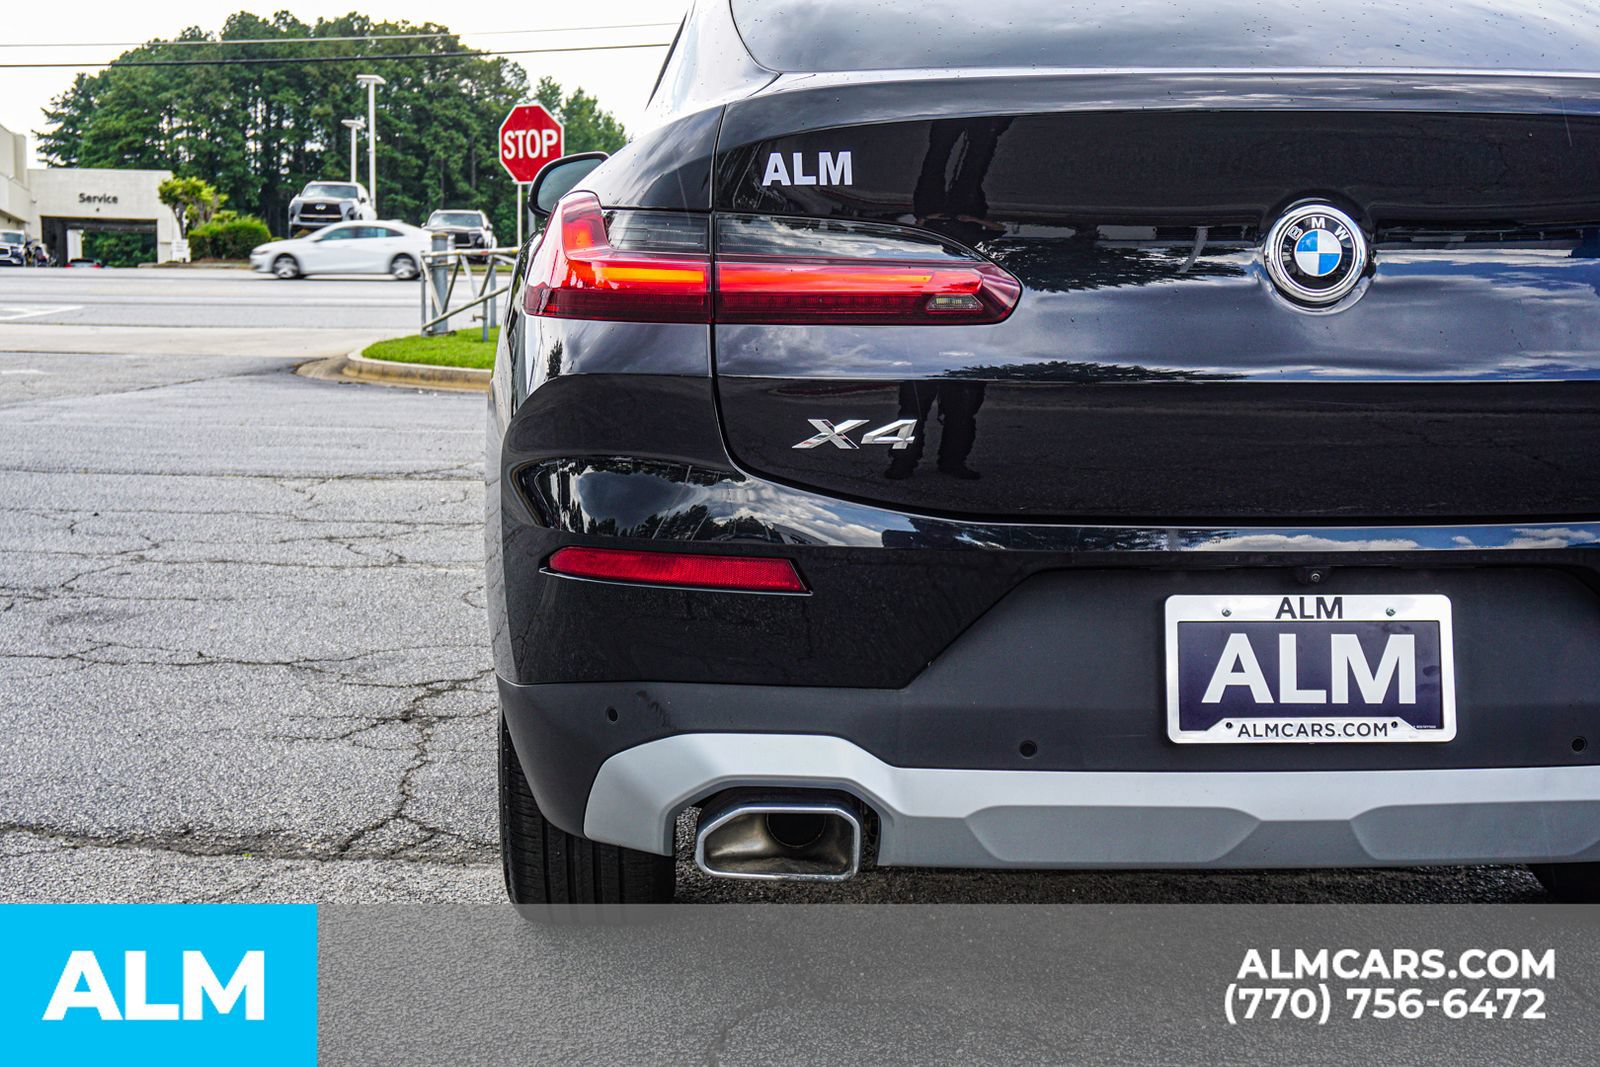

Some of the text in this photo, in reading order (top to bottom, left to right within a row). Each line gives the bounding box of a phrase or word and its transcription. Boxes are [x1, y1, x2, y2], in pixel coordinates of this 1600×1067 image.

[503, 129, 558, 159] STOP
[762, 151, 853, 186] ALM
[79, 193, 118, 204] Service
[1287, 216, 1349, 241] BMW
[792, 419, 918, 449] X4
[1275, 596, 1343, 619] ALM
[1201, 633, 1416, 704] ALM
[1237, 722, 1388, 738] ALMCARS.COM
